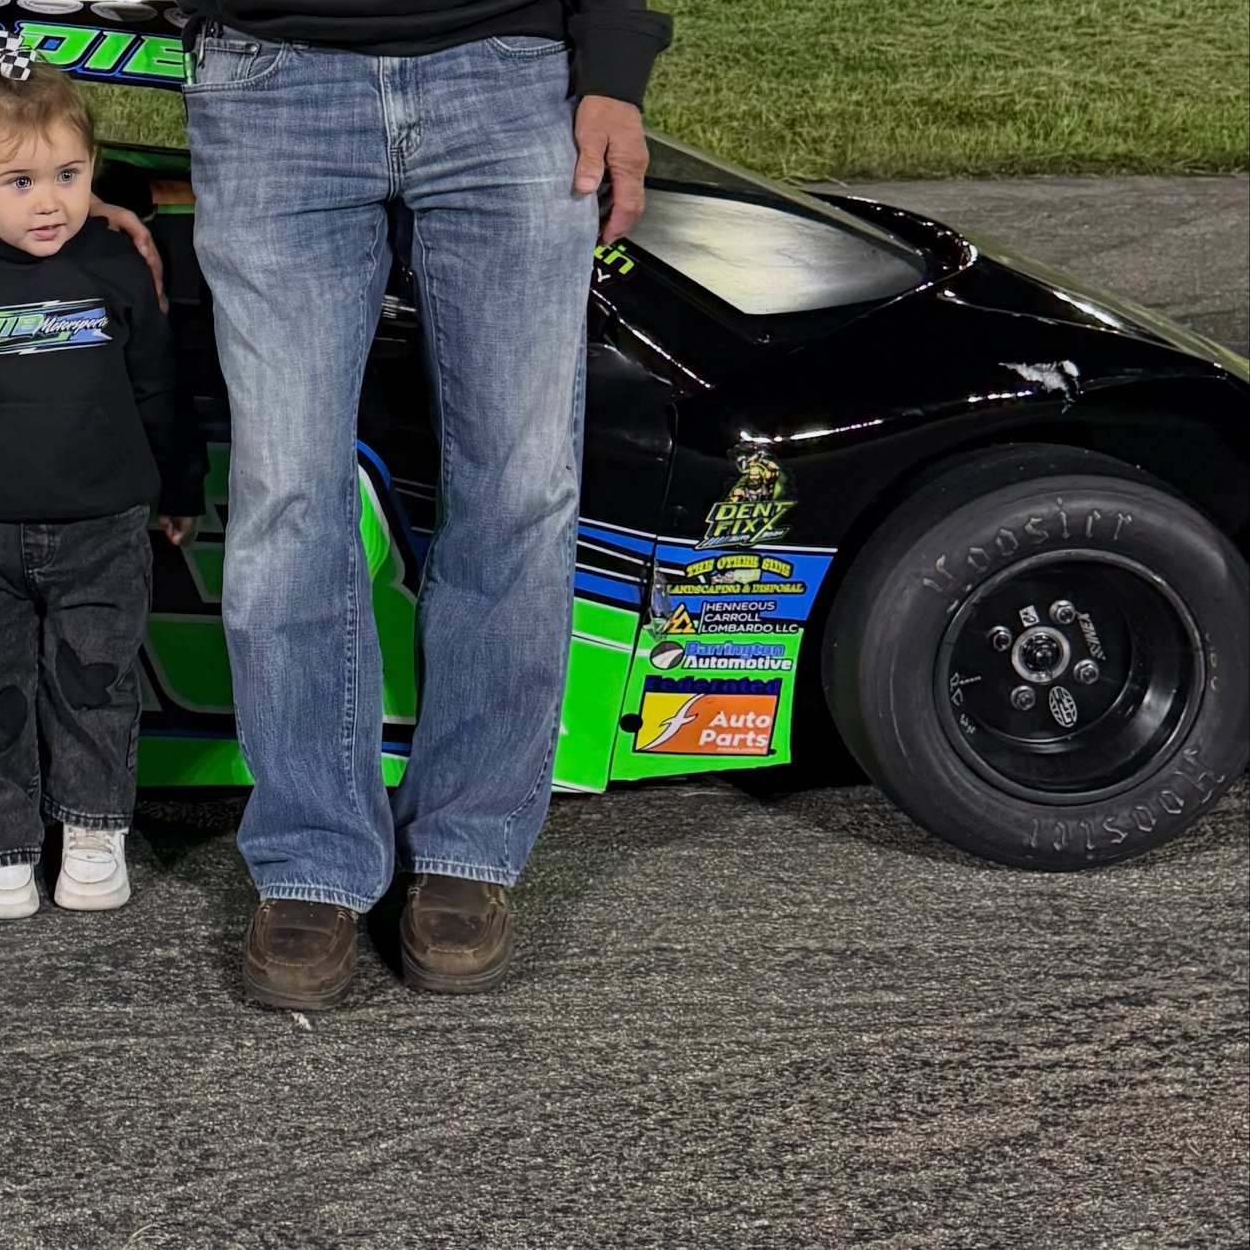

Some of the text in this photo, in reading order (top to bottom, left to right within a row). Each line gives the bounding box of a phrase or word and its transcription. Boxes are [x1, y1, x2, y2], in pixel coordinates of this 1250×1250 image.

[714, 501, 796, 522] DENT
[685, 555, 792, 579] THE OTHER SIDE
[666, 584, 741, 595] LANDSCAPING
[752, 583, 805, 594] DISPOSAL
[706, 601, 776, 612] HENNEOUS
[704, 612, 762, 623] CARROLL
[701, 623, 800, 634] LOMBARDO LLC
[685, 640, 784, 658] Barrington
[683, 655, 794, 671] Automotive
[708, 711, 772, 728] Auto
[698, 729, 769, 747] Parts
